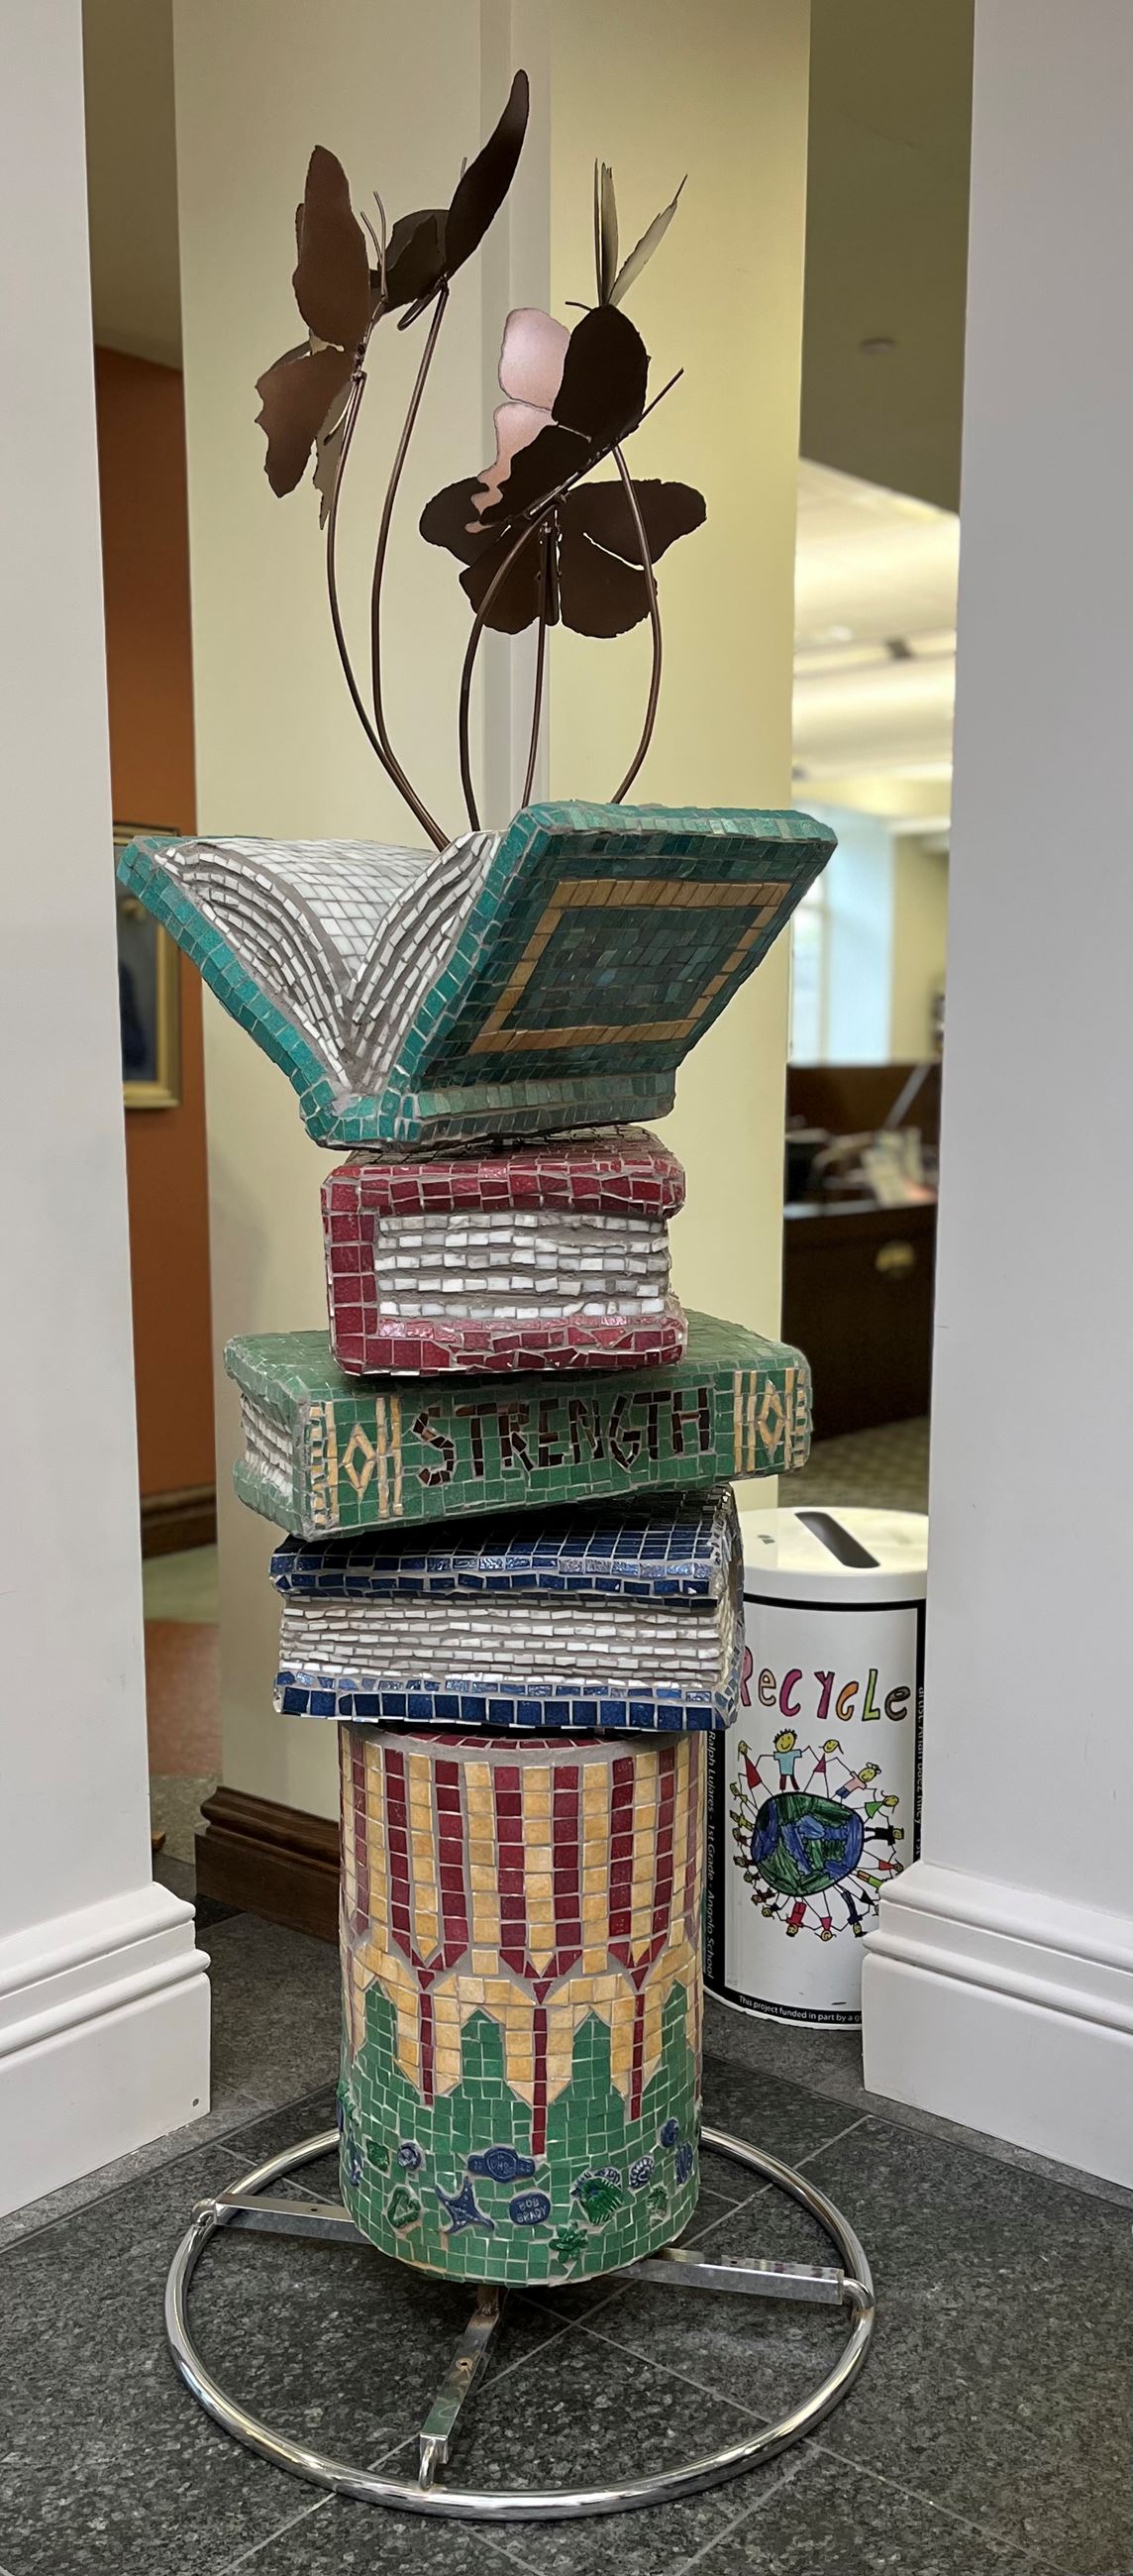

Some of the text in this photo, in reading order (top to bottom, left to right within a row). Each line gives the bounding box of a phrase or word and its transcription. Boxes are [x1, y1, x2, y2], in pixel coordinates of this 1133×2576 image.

[412, 1387, 711, 1486] STRENGTH
[707, 1731, 716, 1766] Ralph
[706, 1769, 716, 1812] Lujares
[706, 1890, 715, 1935] Angelo
[706, 1936, 715, 1980] School
[739, 1995, 753, 2006] This
[753, 2001, 778, 2014] project
[779, 2007, 807, 2019] funded
[818, 2013, 835, 2022] part
[836, 2013, 847, 2022] by
